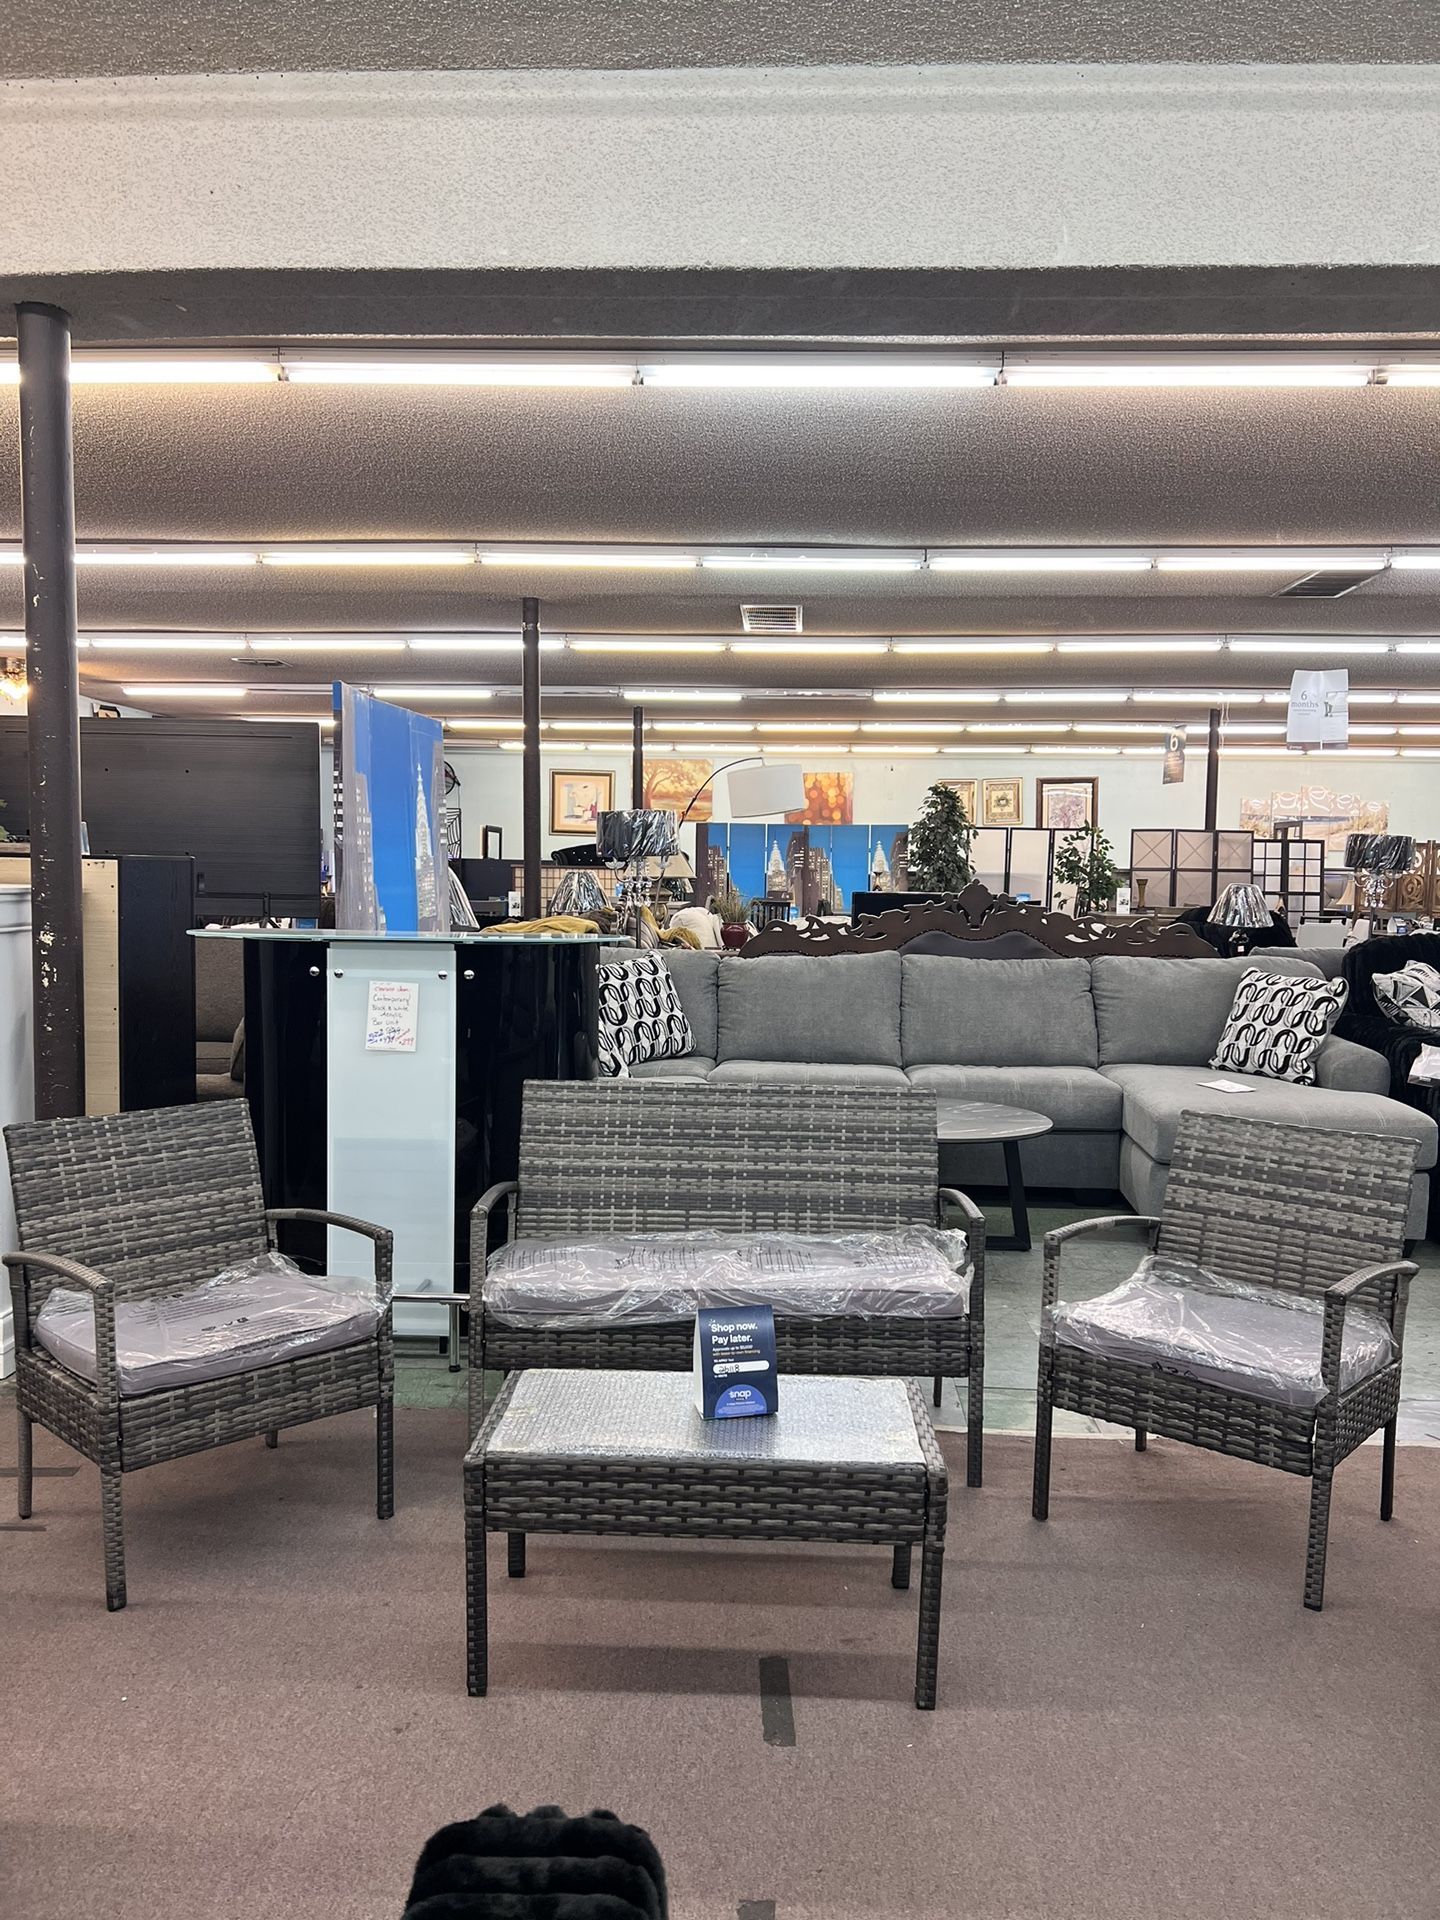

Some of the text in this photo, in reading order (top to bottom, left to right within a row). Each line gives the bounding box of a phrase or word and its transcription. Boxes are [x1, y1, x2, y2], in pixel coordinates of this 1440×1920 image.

[1301, 690, 1308, 701] 6
[1291, 700, 1319, 708] months
[1170, 733, 1179, 751] 6
[711, 1324, 735, 1333] Shop
[712, 1336, 728, 1345] Pay
[729, 1390, 752, 1400] snap
